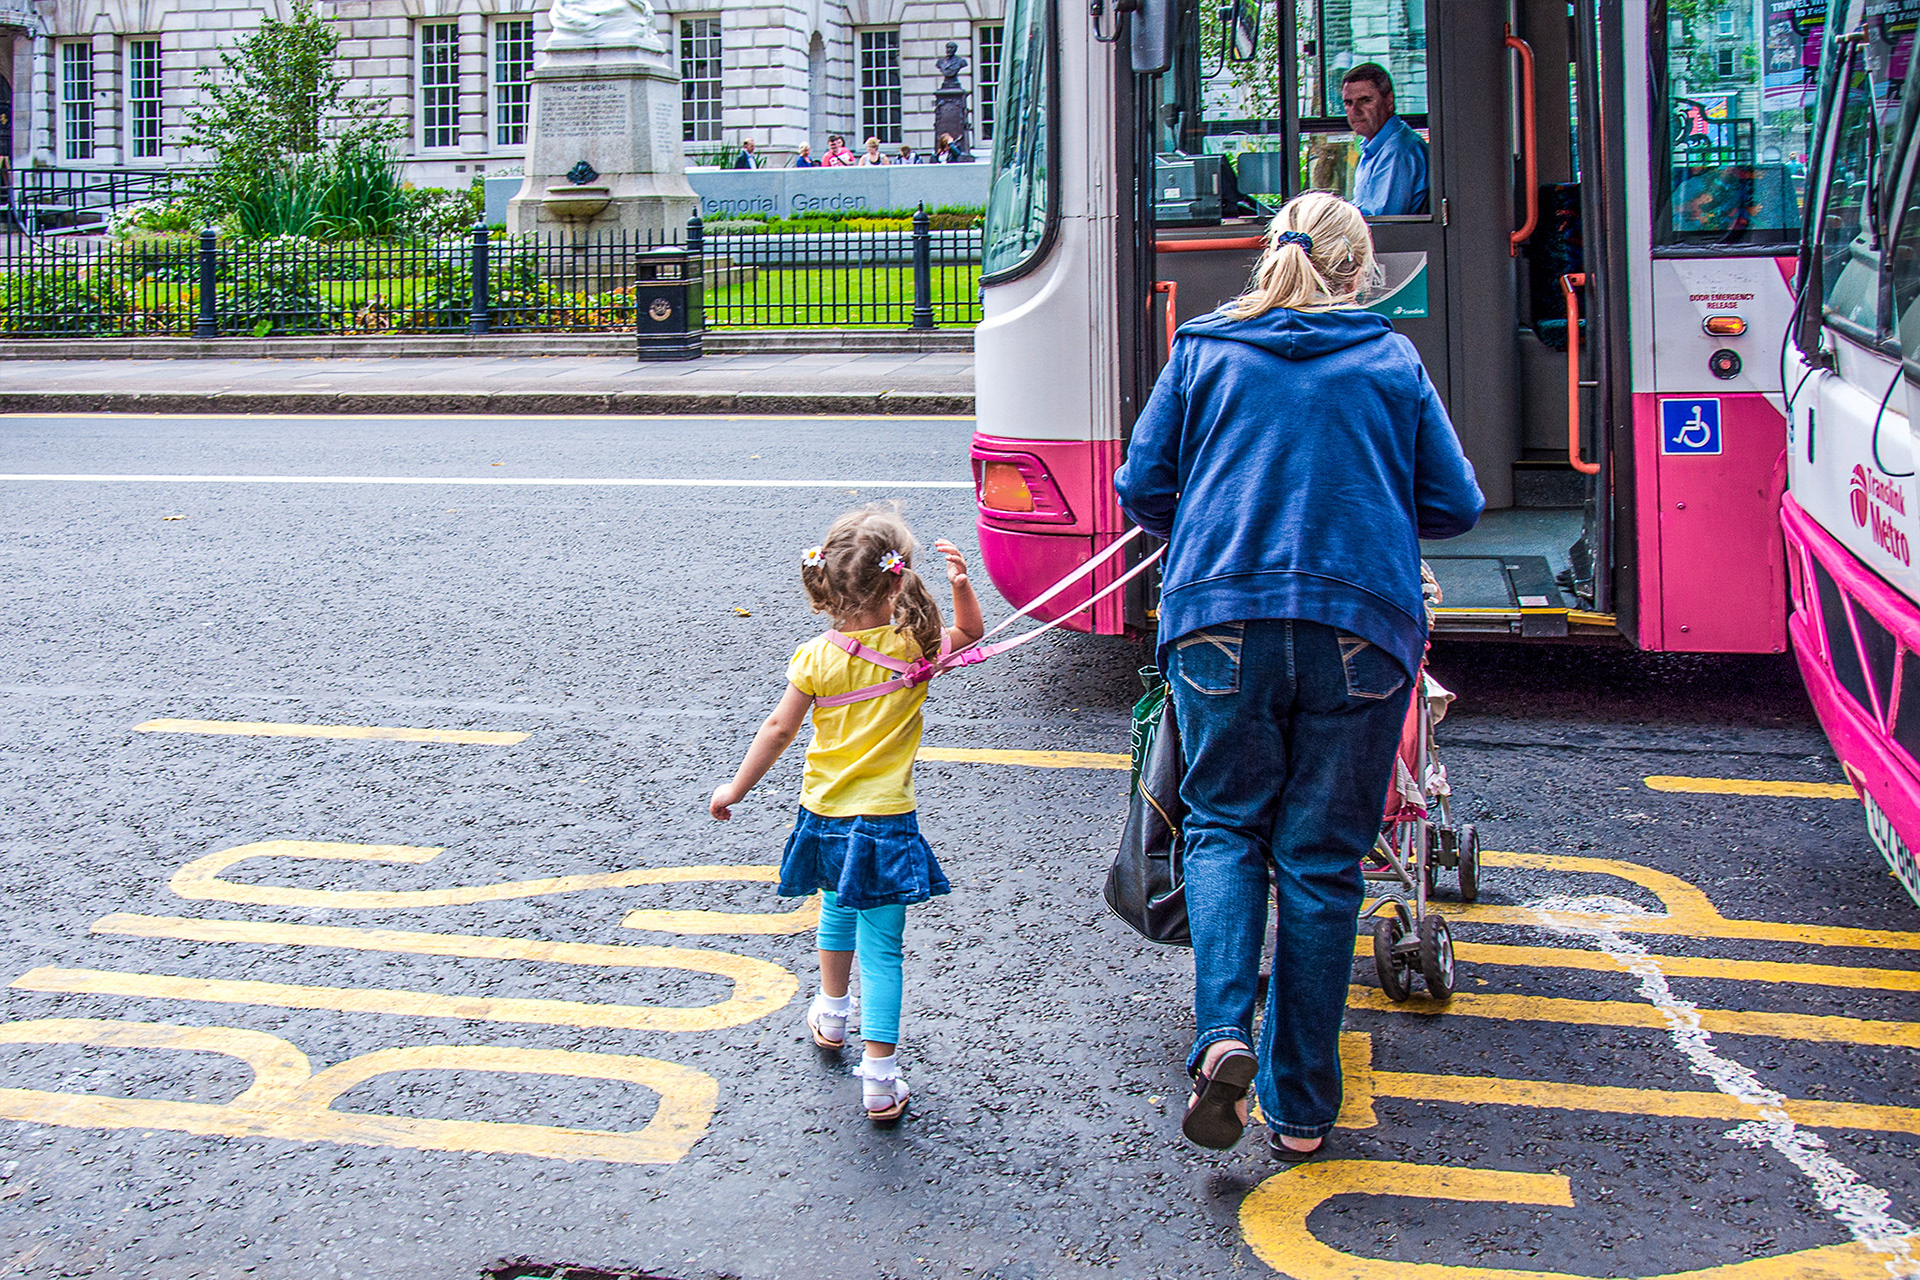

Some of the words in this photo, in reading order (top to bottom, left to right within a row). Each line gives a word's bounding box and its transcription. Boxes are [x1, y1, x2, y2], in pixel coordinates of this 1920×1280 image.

[1866, 2, 1902, 16] RAVEL
[791, 192, 866, 211] Garden
[1707, 301, 1738, 309] RELEASE
[1711, 293, 1755, 301] EMERGENCY
[1869, 501, 1910, 567] Metro
[0, 839, 818, 1163] BUS
